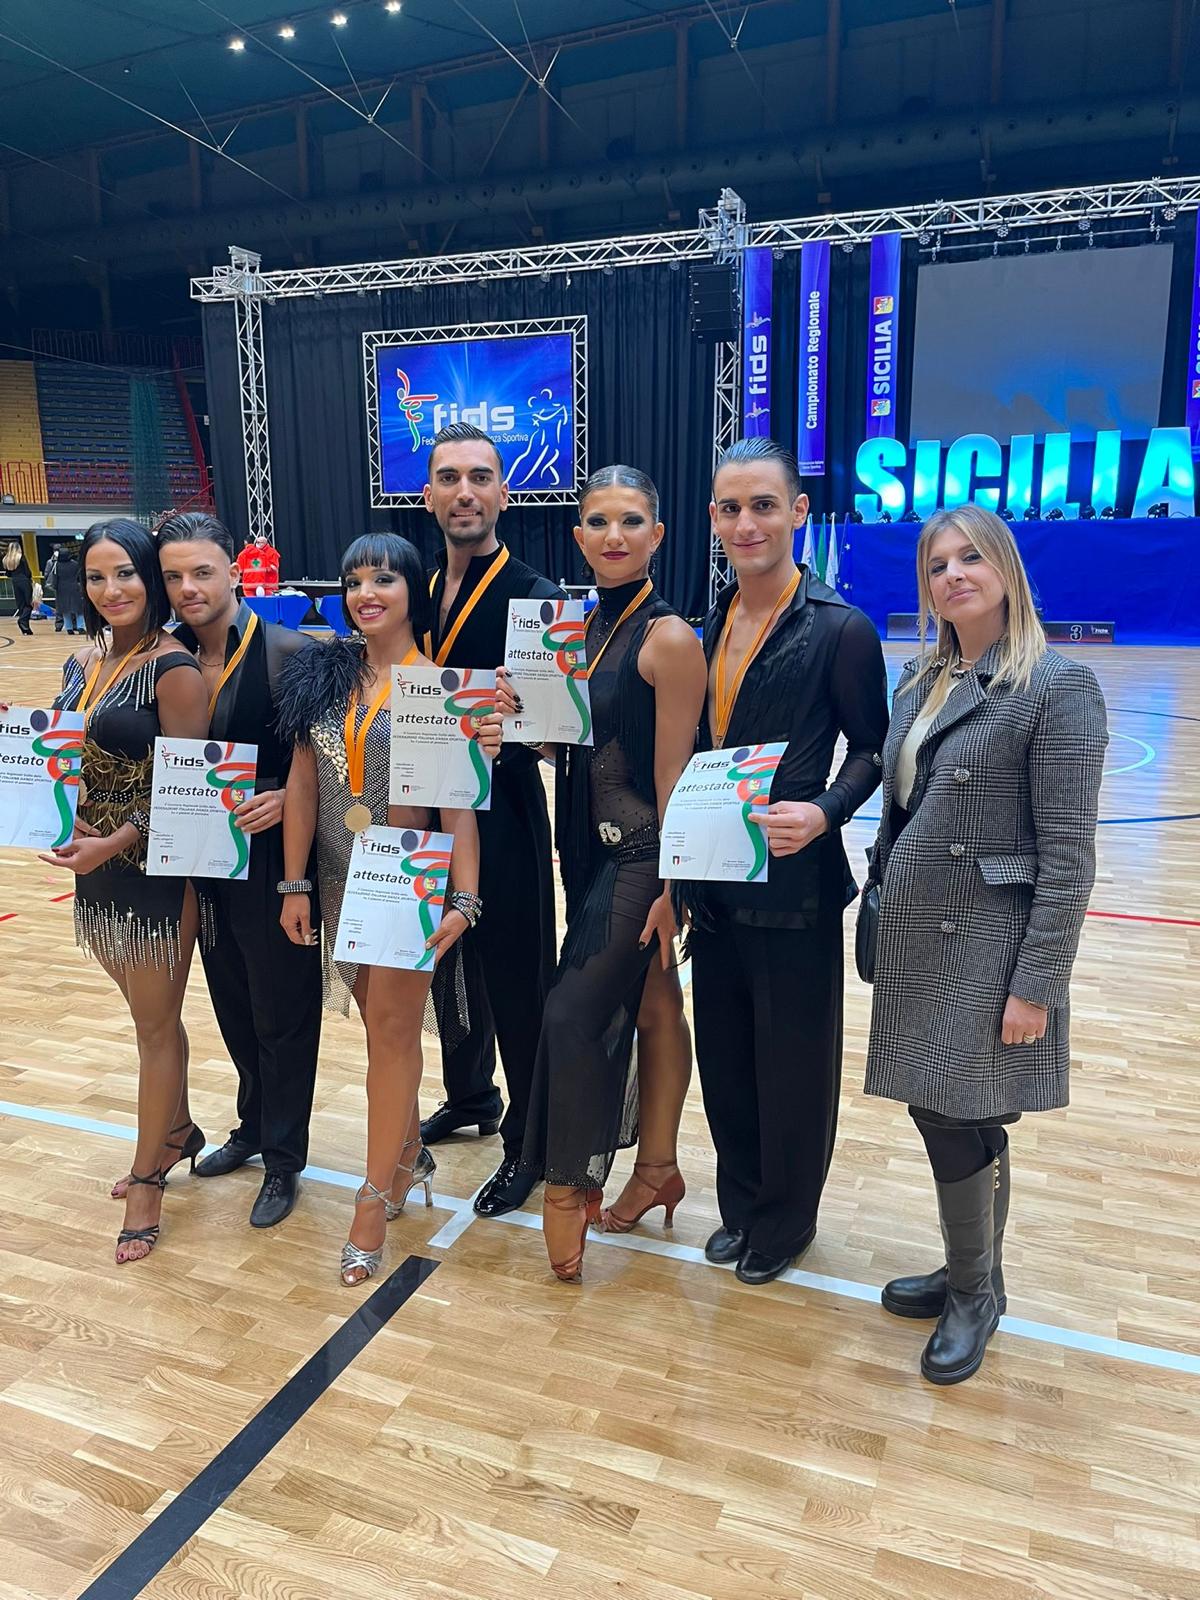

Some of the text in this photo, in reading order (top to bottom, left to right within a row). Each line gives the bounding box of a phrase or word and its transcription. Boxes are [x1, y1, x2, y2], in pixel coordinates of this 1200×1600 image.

[806, 291, 820, 429] Campionato Regionale
[873, 320, 893, 395] SICILIA
[749, 335, 767, 395] fids
[433, 401, 515, 434] fids
[854, 426, 1196, 523] SICILIA
[518, 618, 540, 629] fids
[1069, 625, 1083, 642] 3
[508, 649, 554, 661] attestato
[410, 684, 442, 696] fids
[396, 714, 457, 726] attestato
[0, 753, 44, 766] estato
[173, 756, 204, 768] fids
[158, 785, 219, 798] attestato
[678, 781, 735, 793] attestato
[370, 842, 401, 855] fids
[353, 870, 412, 886] attestato
